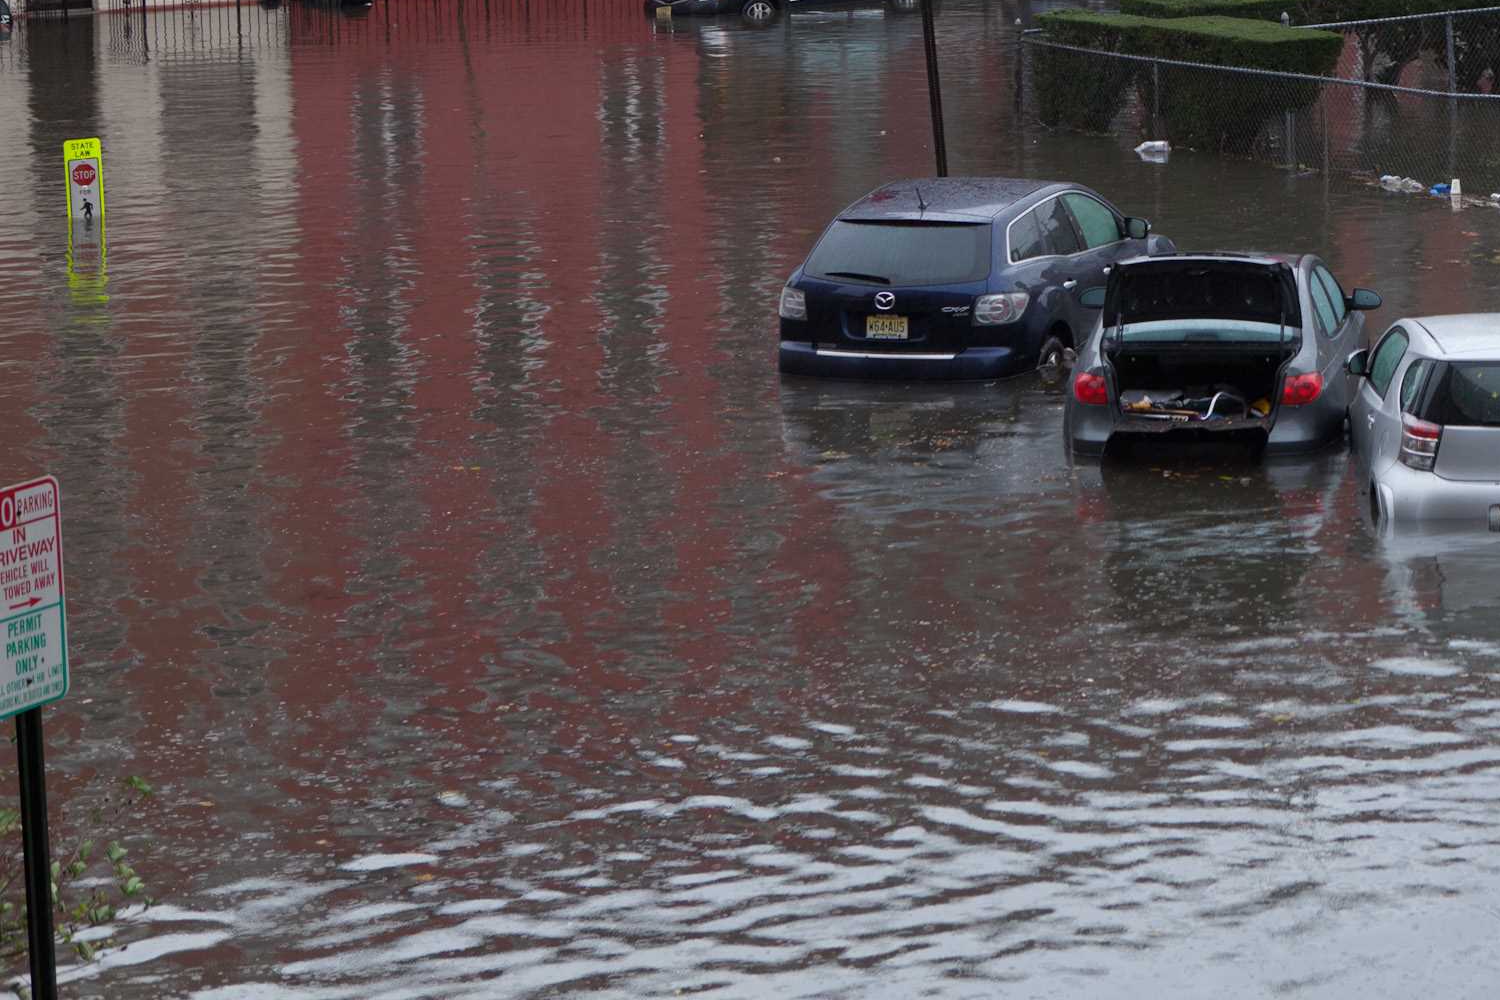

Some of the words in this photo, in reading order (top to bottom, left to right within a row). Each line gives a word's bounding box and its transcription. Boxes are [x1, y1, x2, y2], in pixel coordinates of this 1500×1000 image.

[71, 142, 94, 151] STATE
[75, 150, 90, 158] LAW
[73, 170, 95, 180] STOP
[1, 496, 14, 527] O
[17, 491, 54, 514] PARKING
[12, 527, 26, 545] IN
[0, 536, 54, 567] RIVEWAY
[0, 564, 28, 585] EHICLE
[30, 558, 49, 575] WILL
[4, 580, 31, 601] TOWED
[34, 571, 55, 592] AWAY
[8, 613, 42, 639] PERMIT
[6, 632, 46, 660] PARKING
[15, 653, 38, 676] ONLY
